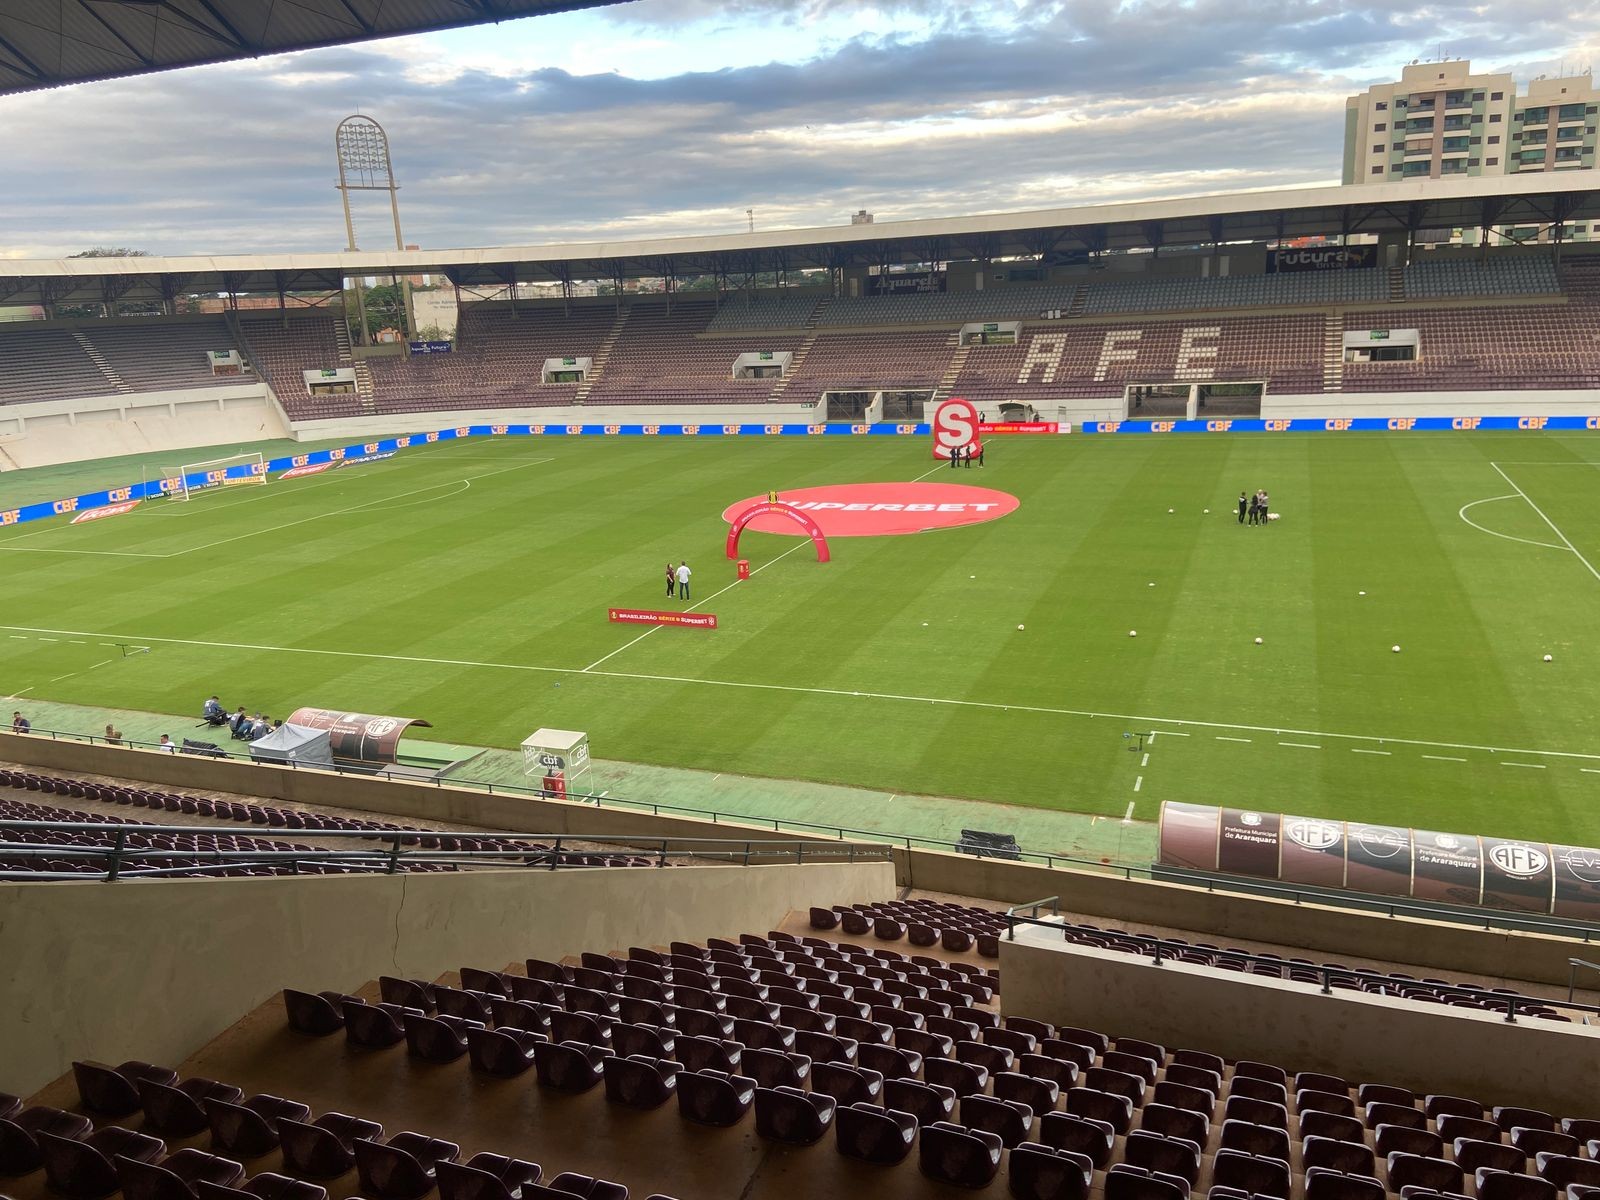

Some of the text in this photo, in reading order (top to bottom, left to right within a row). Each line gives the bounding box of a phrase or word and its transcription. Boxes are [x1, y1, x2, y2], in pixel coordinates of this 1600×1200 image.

[1017, 327, 1221, 384] AFE
[937, 403, 974, 447] S
[1097, 422, 1121, 433] CBF
[1151, 422, 1176, 432] CBF
[1206, 421, 1232, 431] CBF
[1265, 420, 1292, 431] CBF
[1325, 419, 1354, 430] CBF
[1387, 418, 1417, 430] CBF
[1452, 417, 1482, 430] CBF
[1518, 417, 1548, 429] CBF
[456, 427, 470, 437] CBF
[492, 425, 508, 434] CBF
[529, 425, 546, 434] CBF
[566, 425, 583, 434] CBF
[604, 425, 621, 434] CBF
[642, 425, 660, 434] CBF
[682, 425, 700, 434] CBF
[723, 425, 741, 434] CBF
[764, 425, 783, 434] CBF
[807, 425, 827, 434] CBF
[851, 424, 871, 434] CBF
[896, 424, 917, 434] CBF
[396, 437, 411, 448] CBF
[426, 432, 440, 442] CBF
[364, 442, 379, 454] CBF
[330, 448, 345, 460] CBF
[292, 454, 309, 468] CBF
[251, 461, 270, 474] CBF
[207, 469, 228, 482] CBF
[160, 477, 183, 492] CBF
[108, 487, 131, 503] CBF
[53, 498, 78, 515] CBF
[753, 500, 999, 512] UPERBET
[543, 755, 558, 765] cbf
[1224, 826, 1278, 838] Prefeitura Municipal
[1234, 833, 1277, 844] Araraquara
[1430, 856, 1477, 869] Araraquara
[1559, 855, 1600, 869] REV
